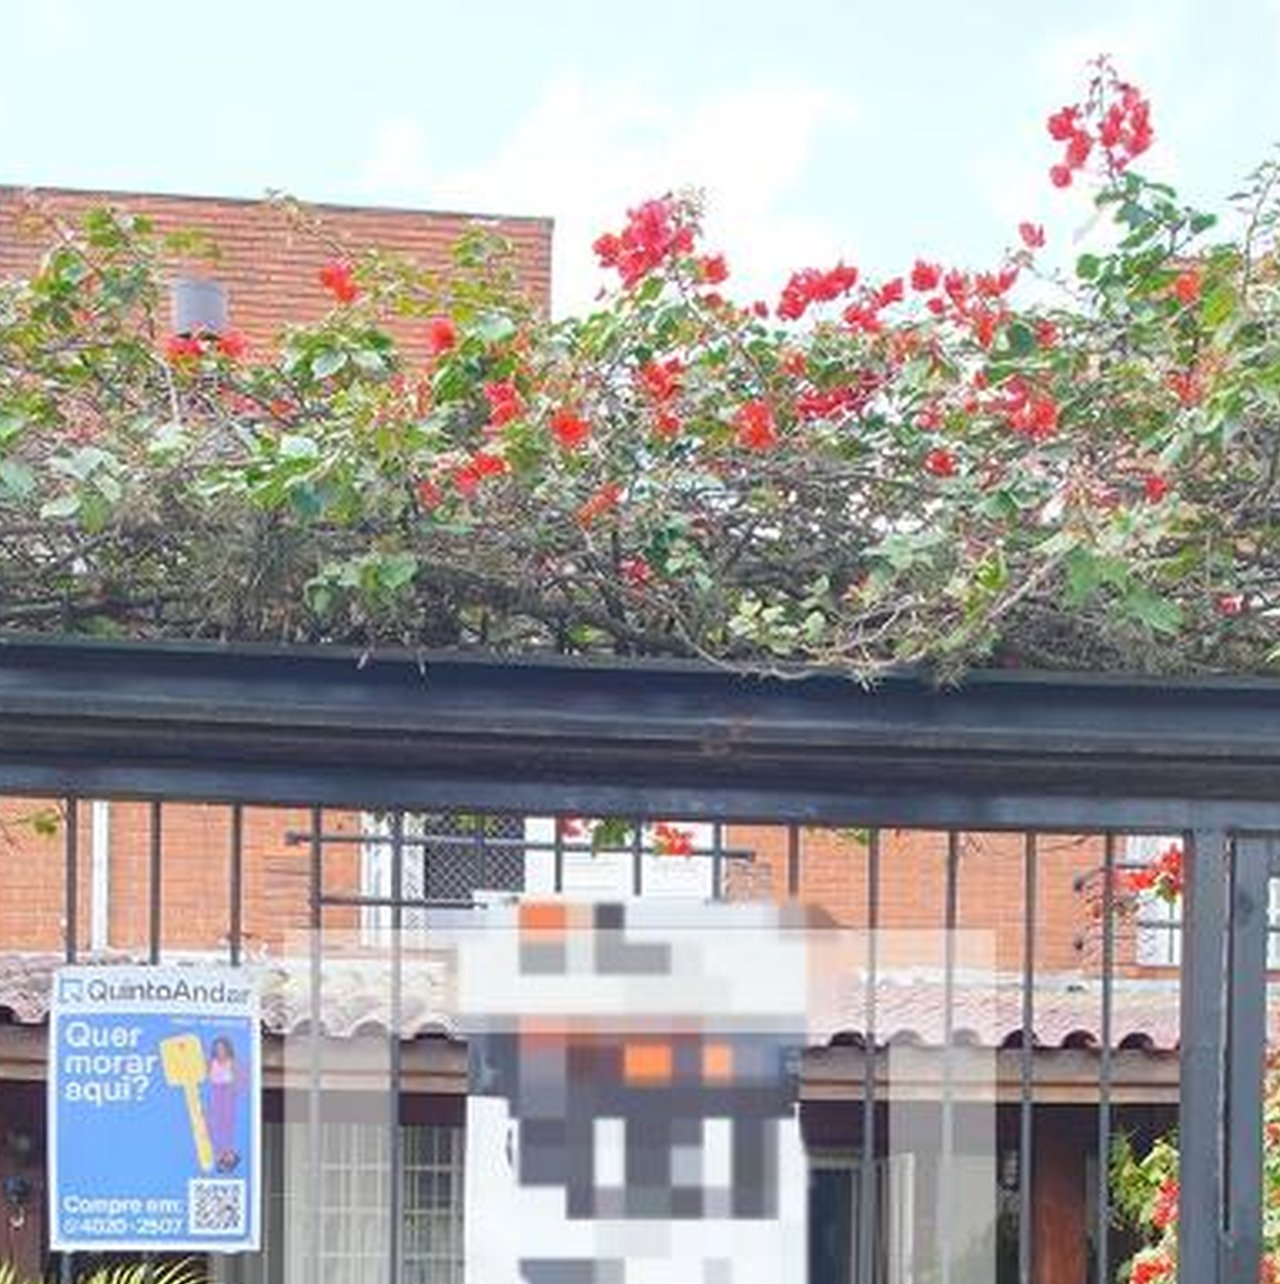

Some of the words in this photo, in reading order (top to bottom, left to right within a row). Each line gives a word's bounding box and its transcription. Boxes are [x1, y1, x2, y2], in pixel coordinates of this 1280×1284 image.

[64, 1021, 143, 1049] Quer
[64, 1053, 158, 1075] morar
[64, 1074, 150, 1107] aqui?
